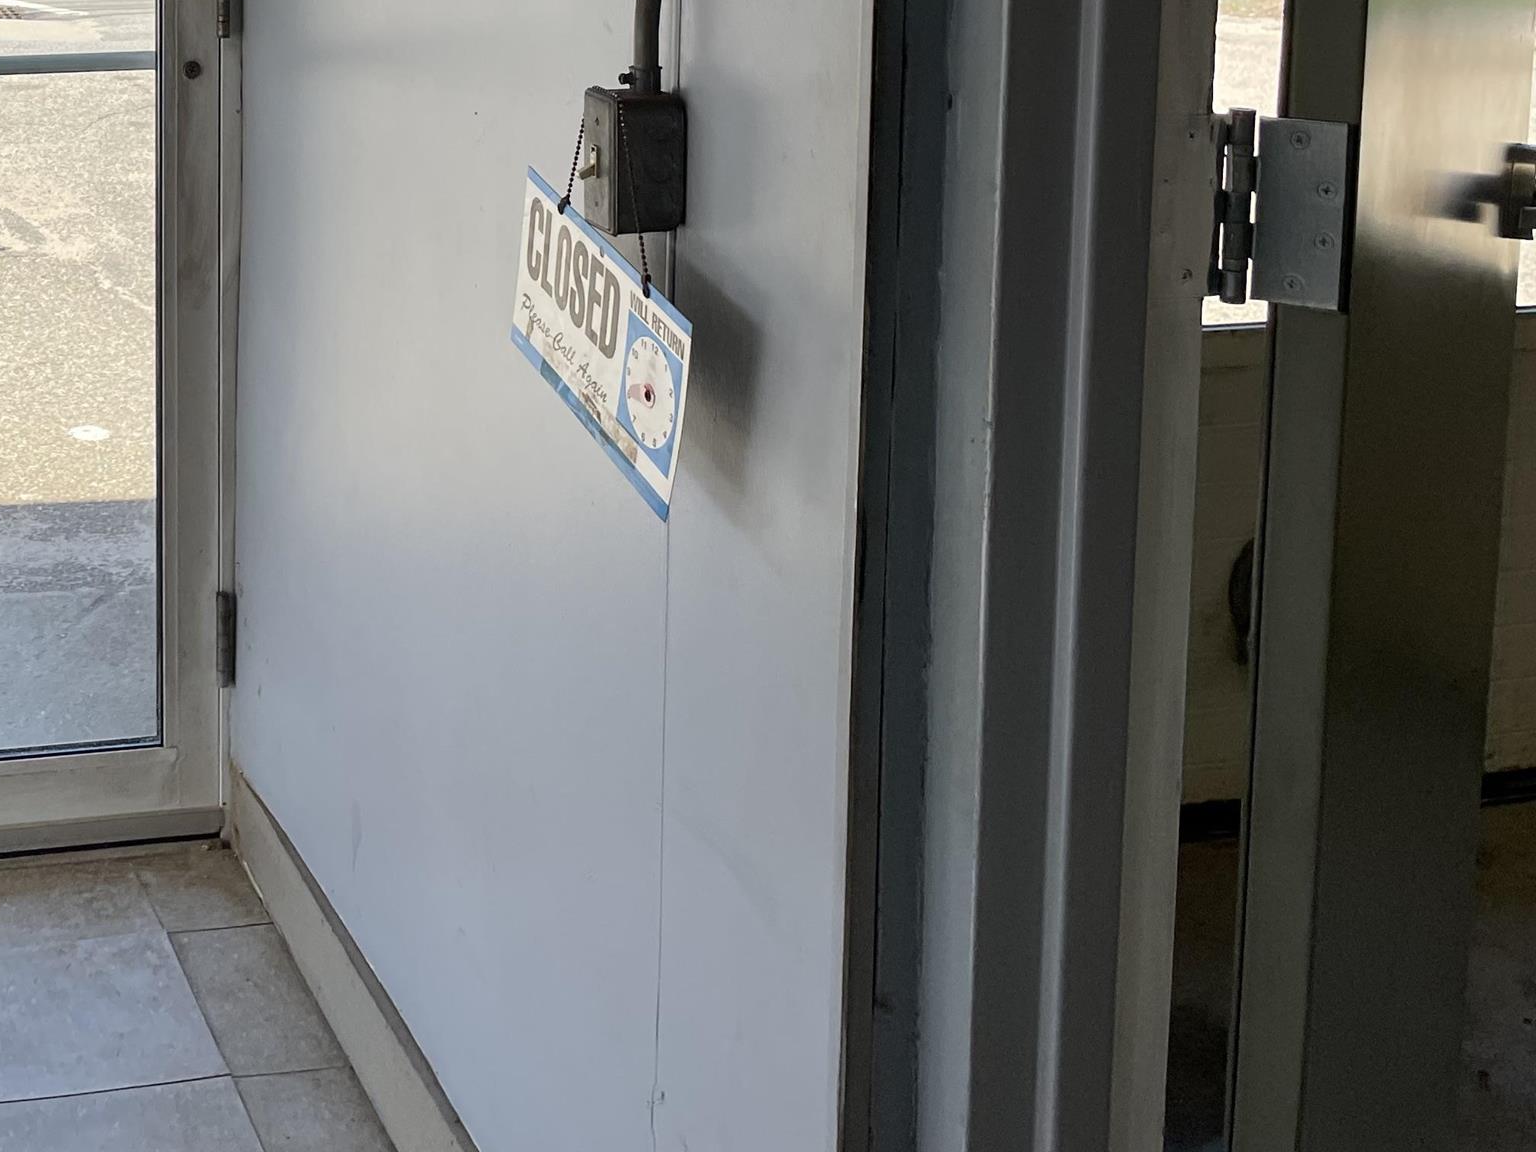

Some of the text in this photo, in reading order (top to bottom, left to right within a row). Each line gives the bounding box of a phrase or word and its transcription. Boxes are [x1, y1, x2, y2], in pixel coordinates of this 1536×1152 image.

[526, 196, 621, 360] CLOSED
[630, 288, 685, 361] WILL RETURN
[520, 292, 608, 403] Please Call Again
